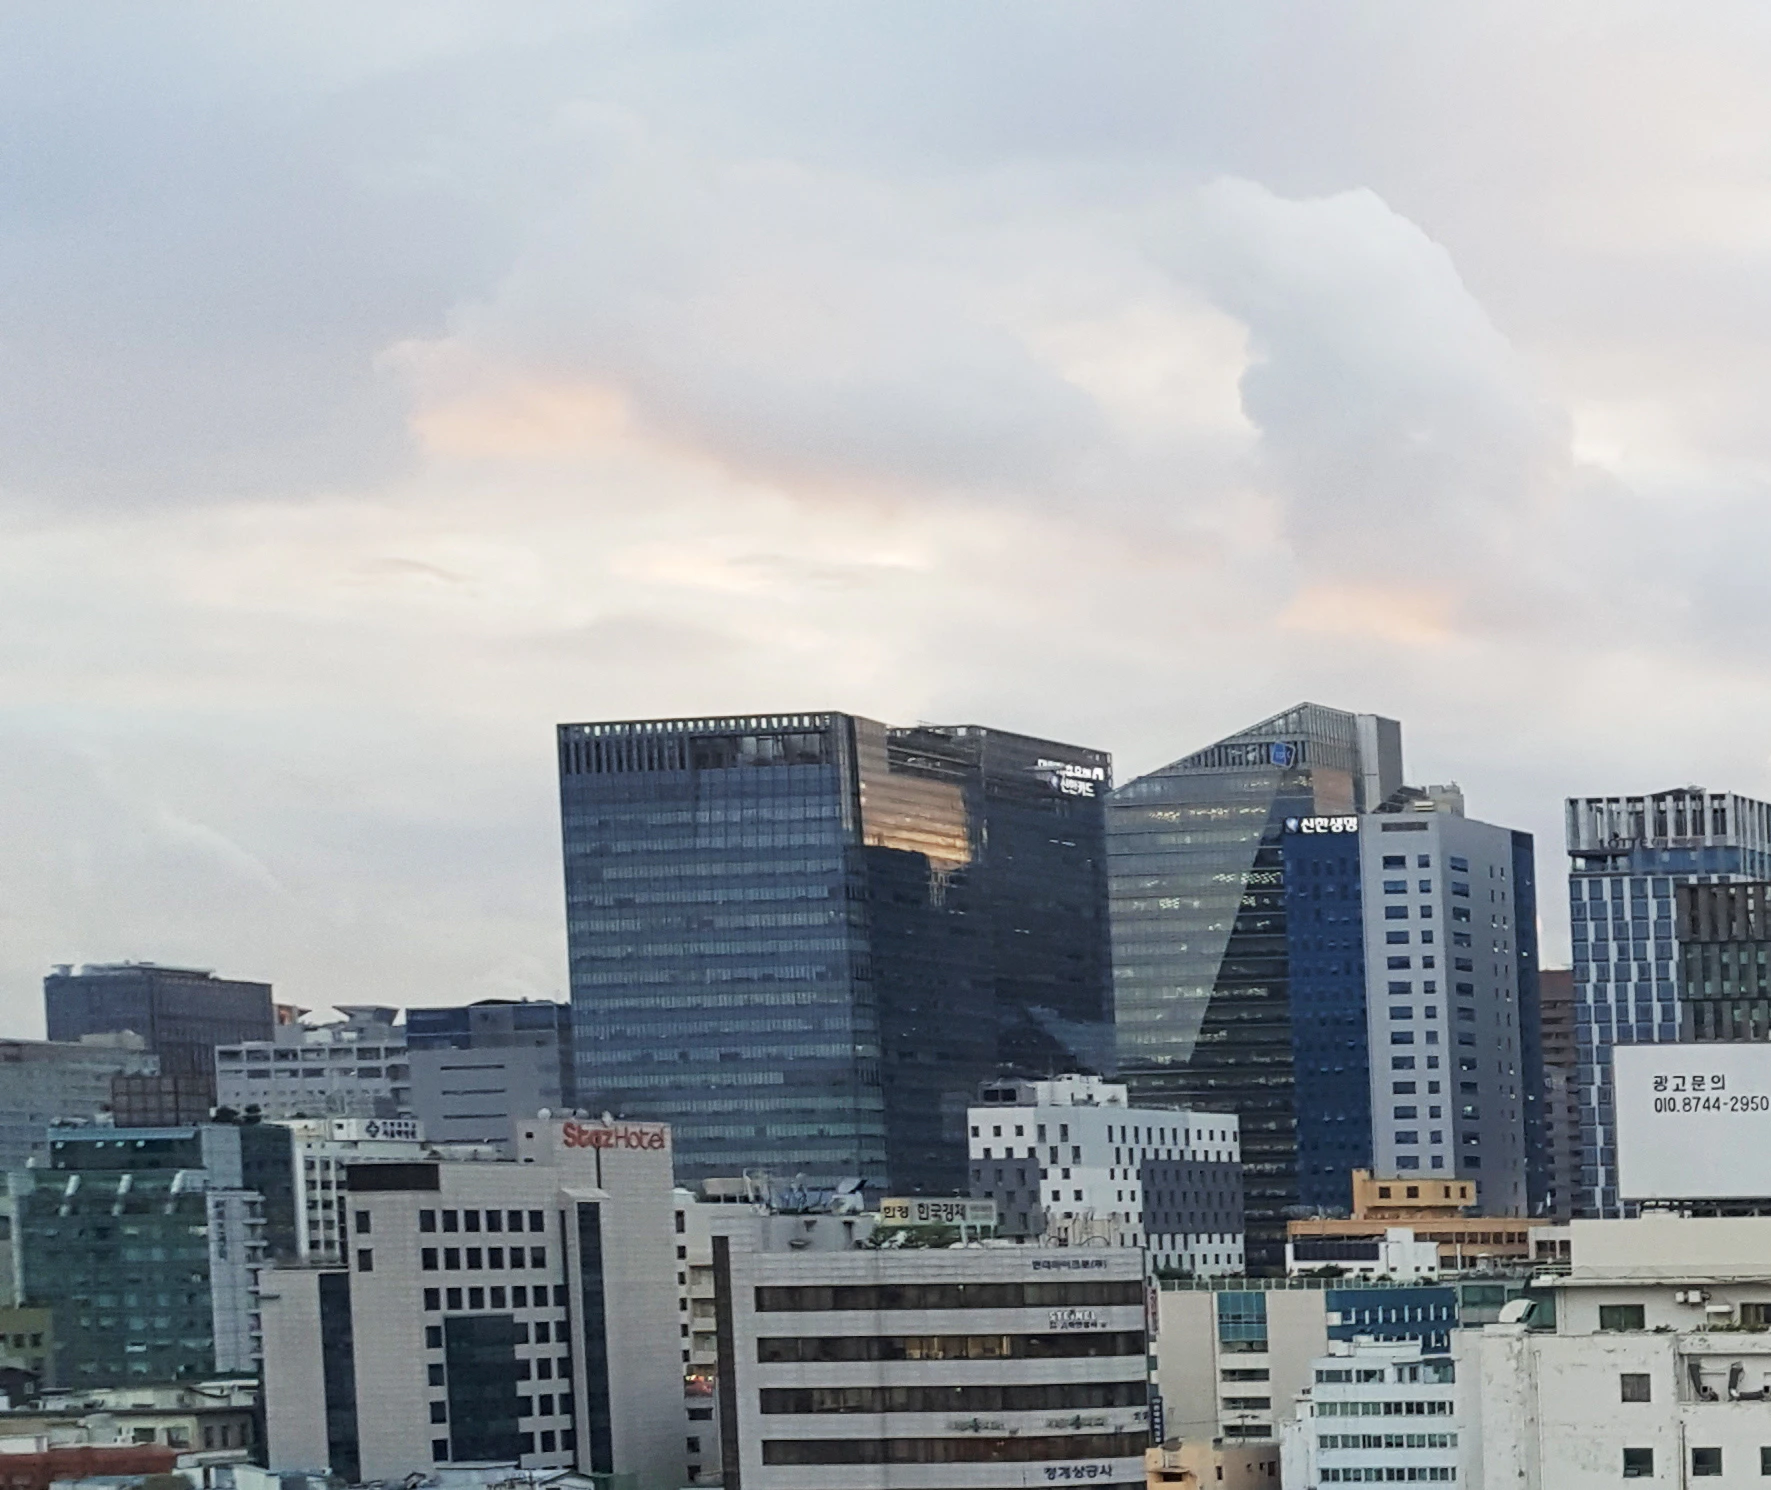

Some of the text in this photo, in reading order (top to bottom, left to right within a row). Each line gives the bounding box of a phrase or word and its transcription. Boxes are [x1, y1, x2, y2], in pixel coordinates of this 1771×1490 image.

[1301, 817, 1358, 833] 신한생명
[1653, 1074, 1725, 1092] 광고문의
[1654, 1096, 1769, 1113] 010.8744-2950
[884, 1203, 966, 1221] 한경 한국경제
